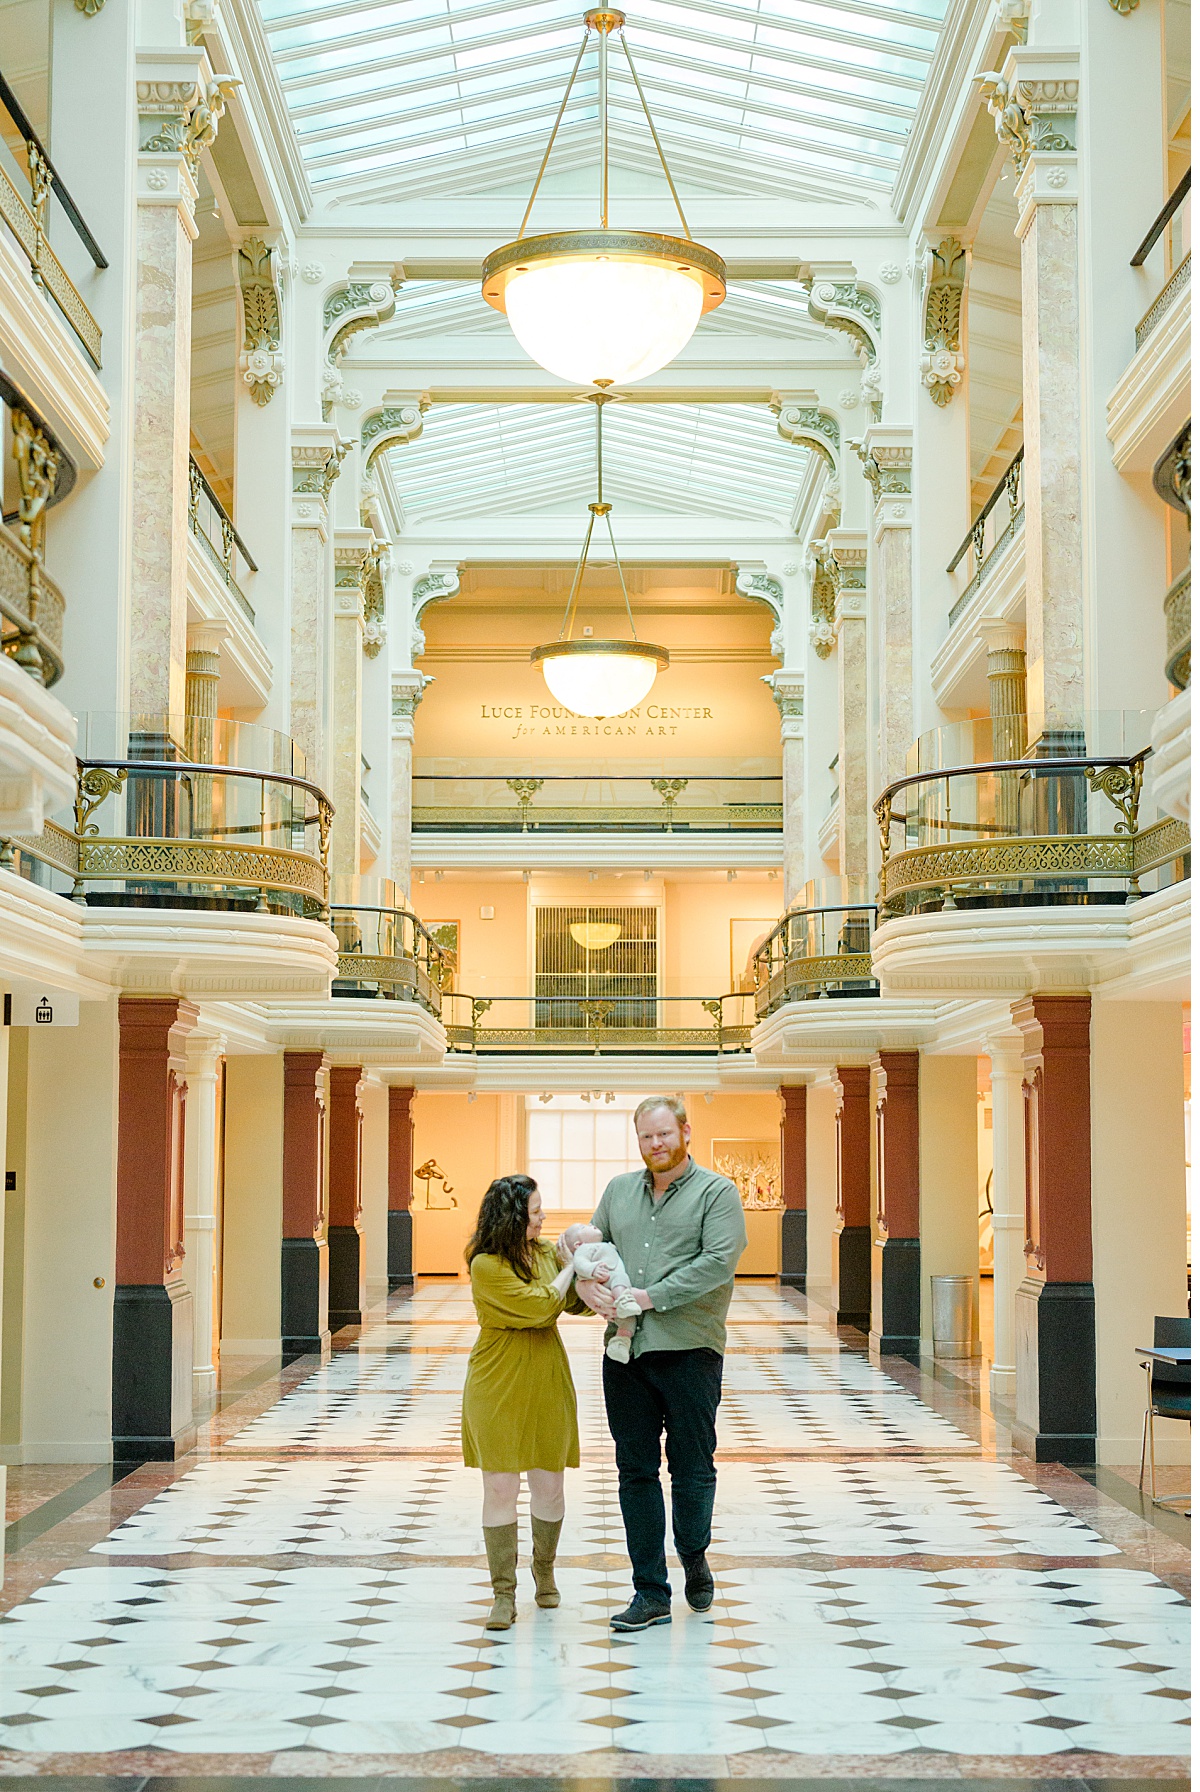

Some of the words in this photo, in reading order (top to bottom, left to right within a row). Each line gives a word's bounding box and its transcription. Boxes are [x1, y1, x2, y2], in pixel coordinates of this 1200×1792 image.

[481, 705, 522, 718] LUCE
[646, 705, 713, 718] CENTER
[512, 723, 535, 739] for
[542, 726, 636, 735] AMERICAN
[646, 726, 677, 735] ART
